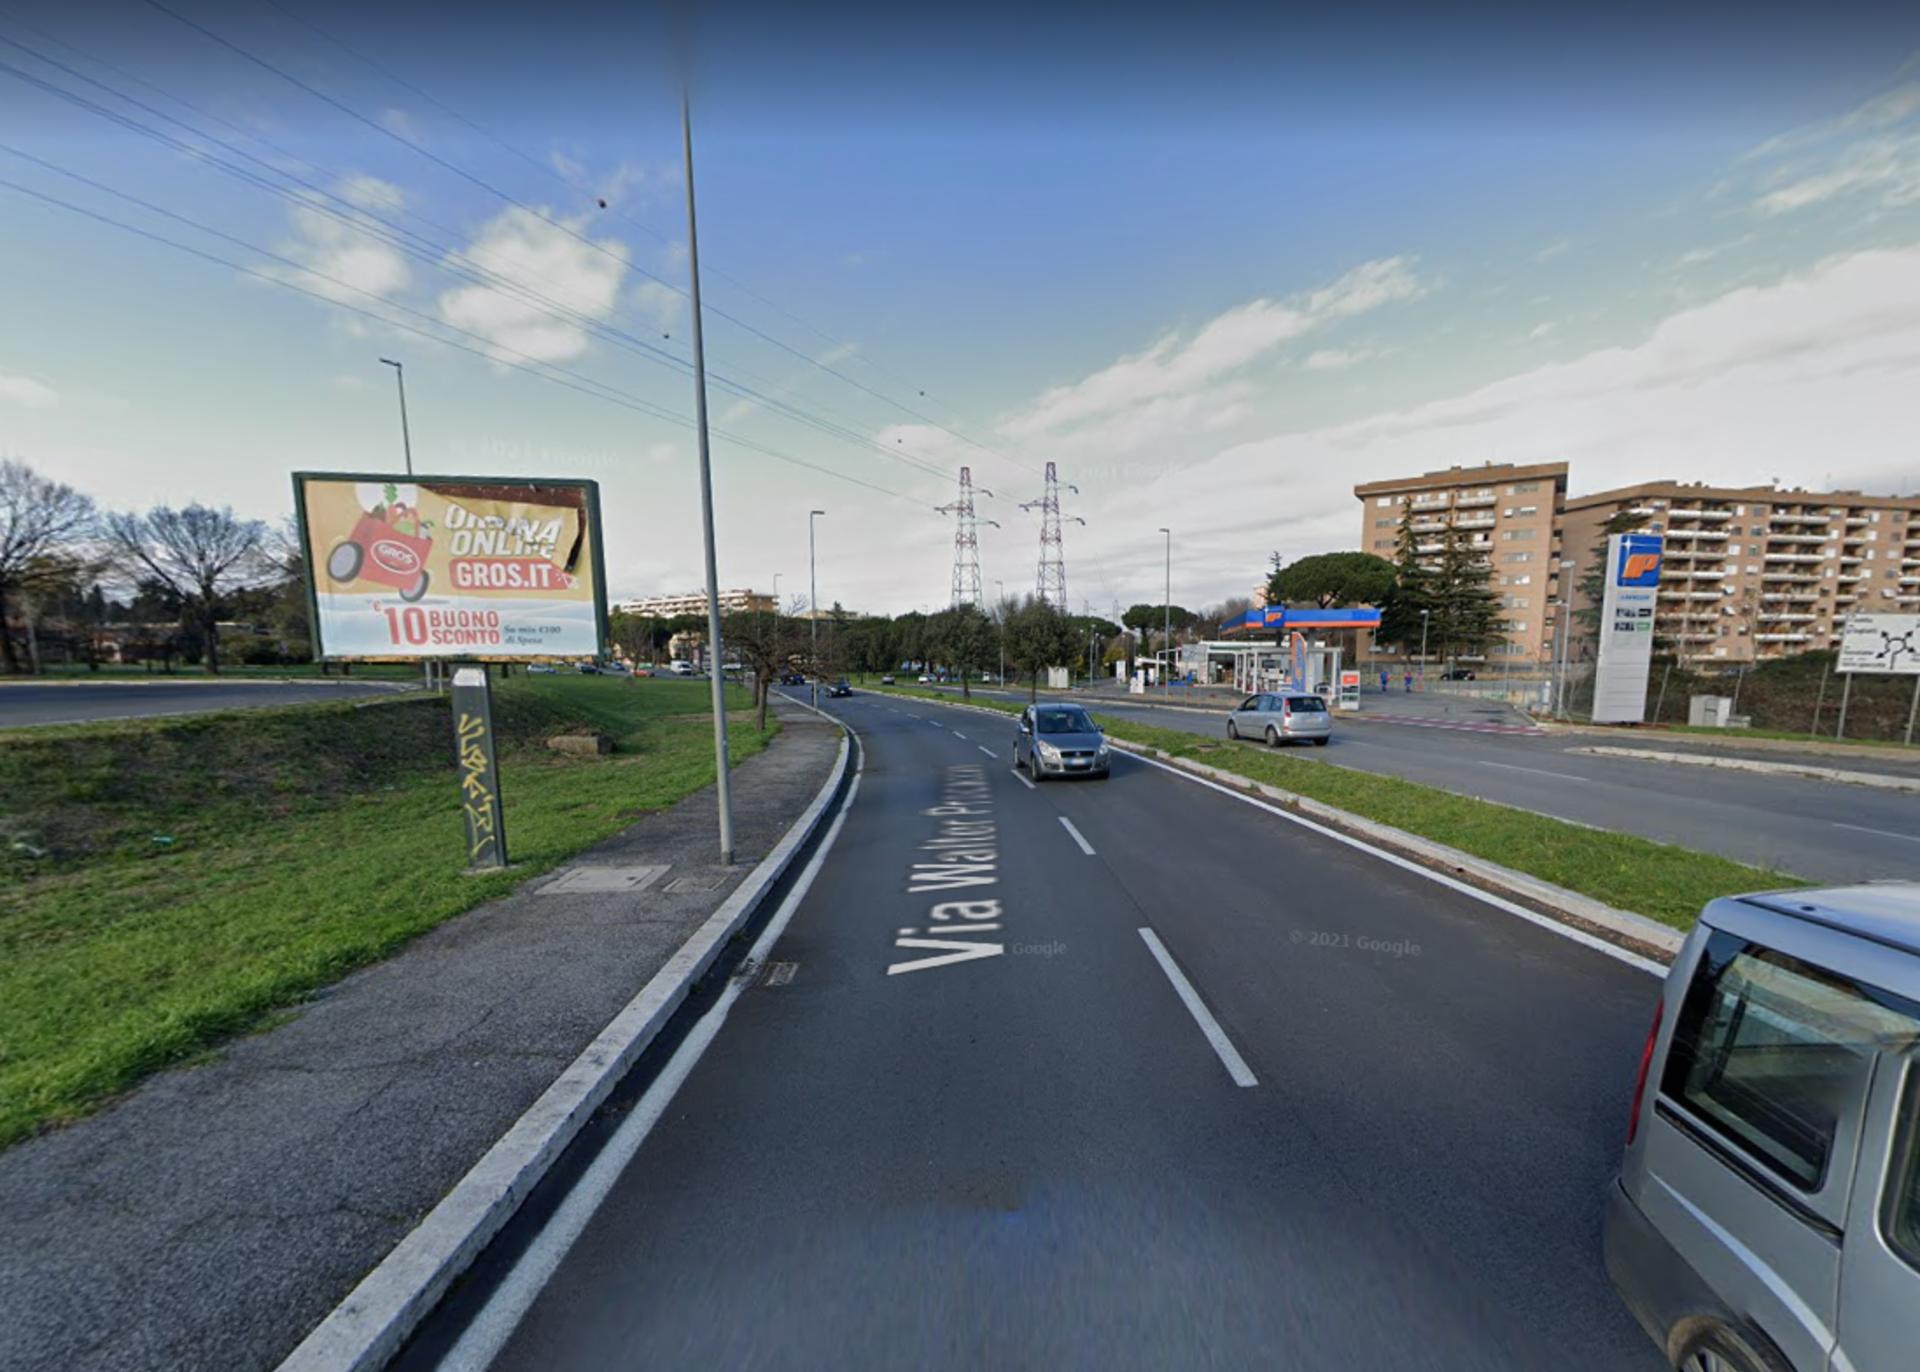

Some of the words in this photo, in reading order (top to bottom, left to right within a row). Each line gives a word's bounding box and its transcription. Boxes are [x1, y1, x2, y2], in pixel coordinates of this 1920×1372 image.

[378, 543, 414, 565] GROS
[456, 561, 552, 588] GROS.IT
[384, 607, 428, 646] 10
[429, 610, 499, 627] BUONO
[431, 628, 500, 646] SCONTO
